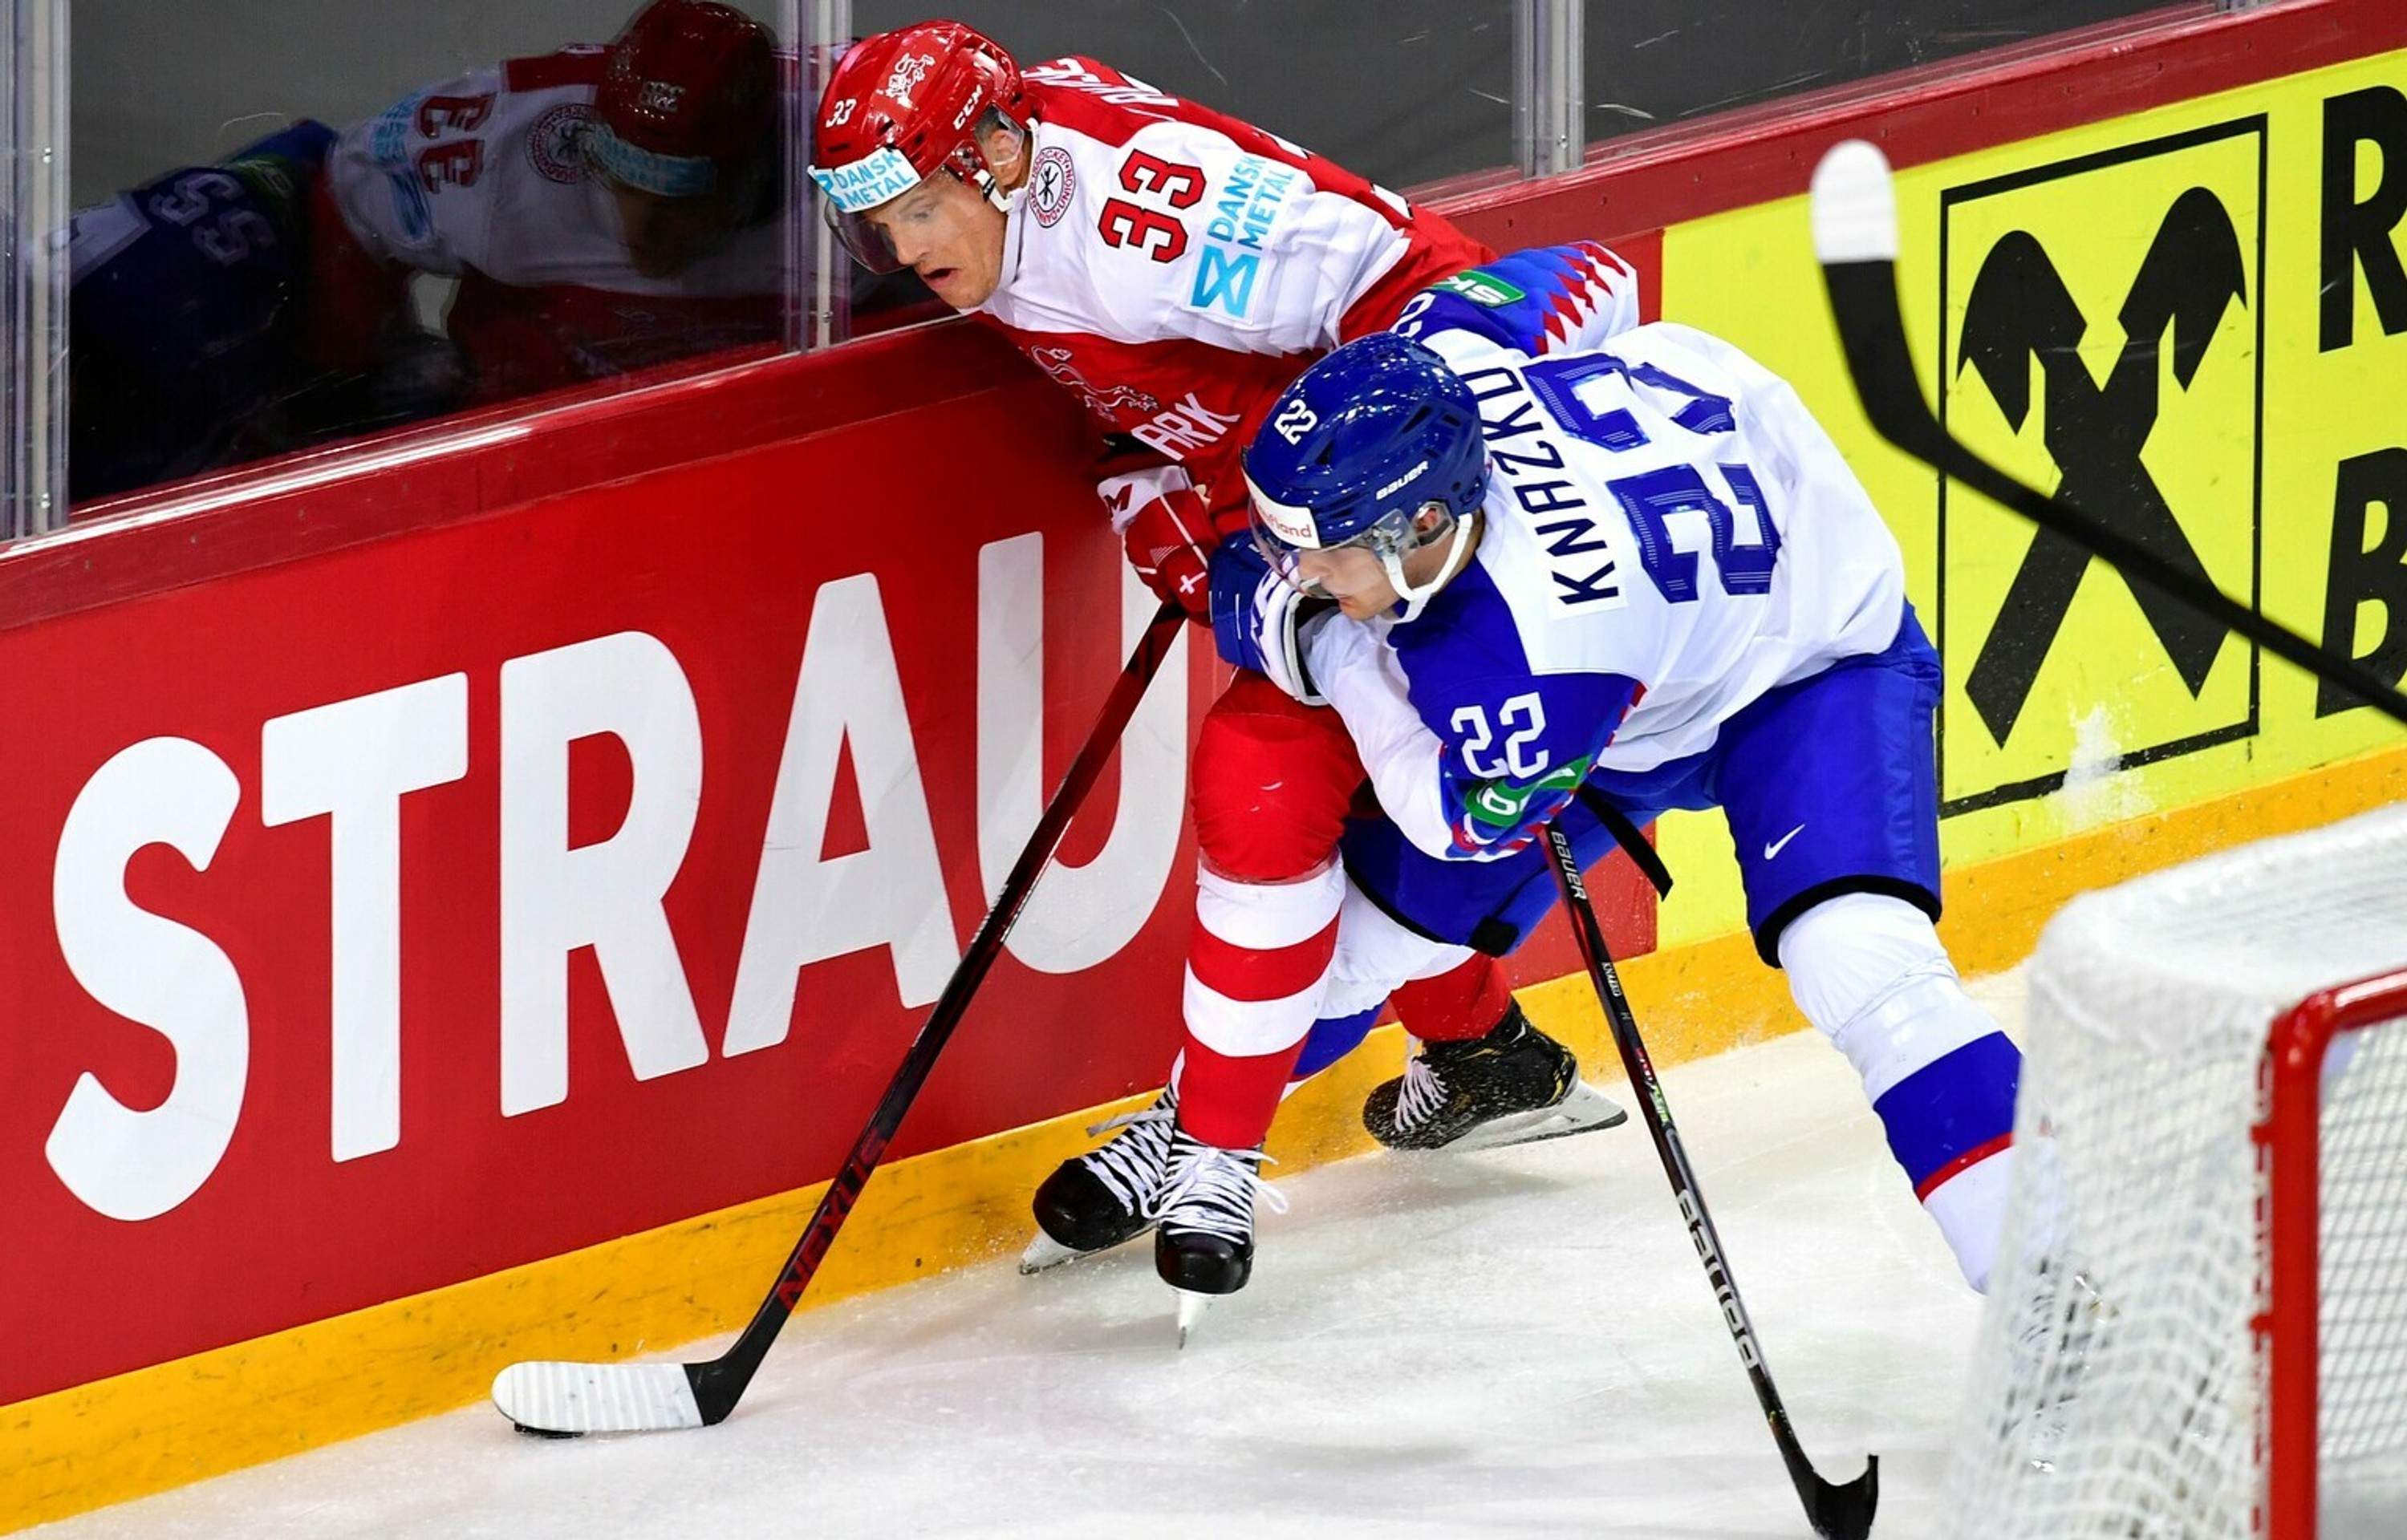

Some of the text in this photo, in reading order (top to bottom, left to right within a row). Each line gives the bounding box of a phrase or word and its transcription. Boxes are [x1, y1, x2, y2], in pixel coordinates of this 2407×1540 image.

[826, 98, 857, 128] 33
[953, 84, 983, 130] CCM
[833, 145, 902, 189] DANSK
[845, 170, 913, 208] METAL
[1098, 148, 1208, 265] 33
[1208, 152, 1267, 243] DANSK
[1237, 168, 1297, 251] METAL
[1130, 391, 1241, 461] ARK
[1274, 399, 1317, 445] 22
[1375, 460, 1429, 501] BAUER
[1456, 366, 1620, 606] KNAZKO
[1520, 351, 1782, 605] 22
[1450, 691, 1549, 780] 22
[44, 529, 1191, 1222] STRAU
[777, 1126, 889, 1312] NEXUS
